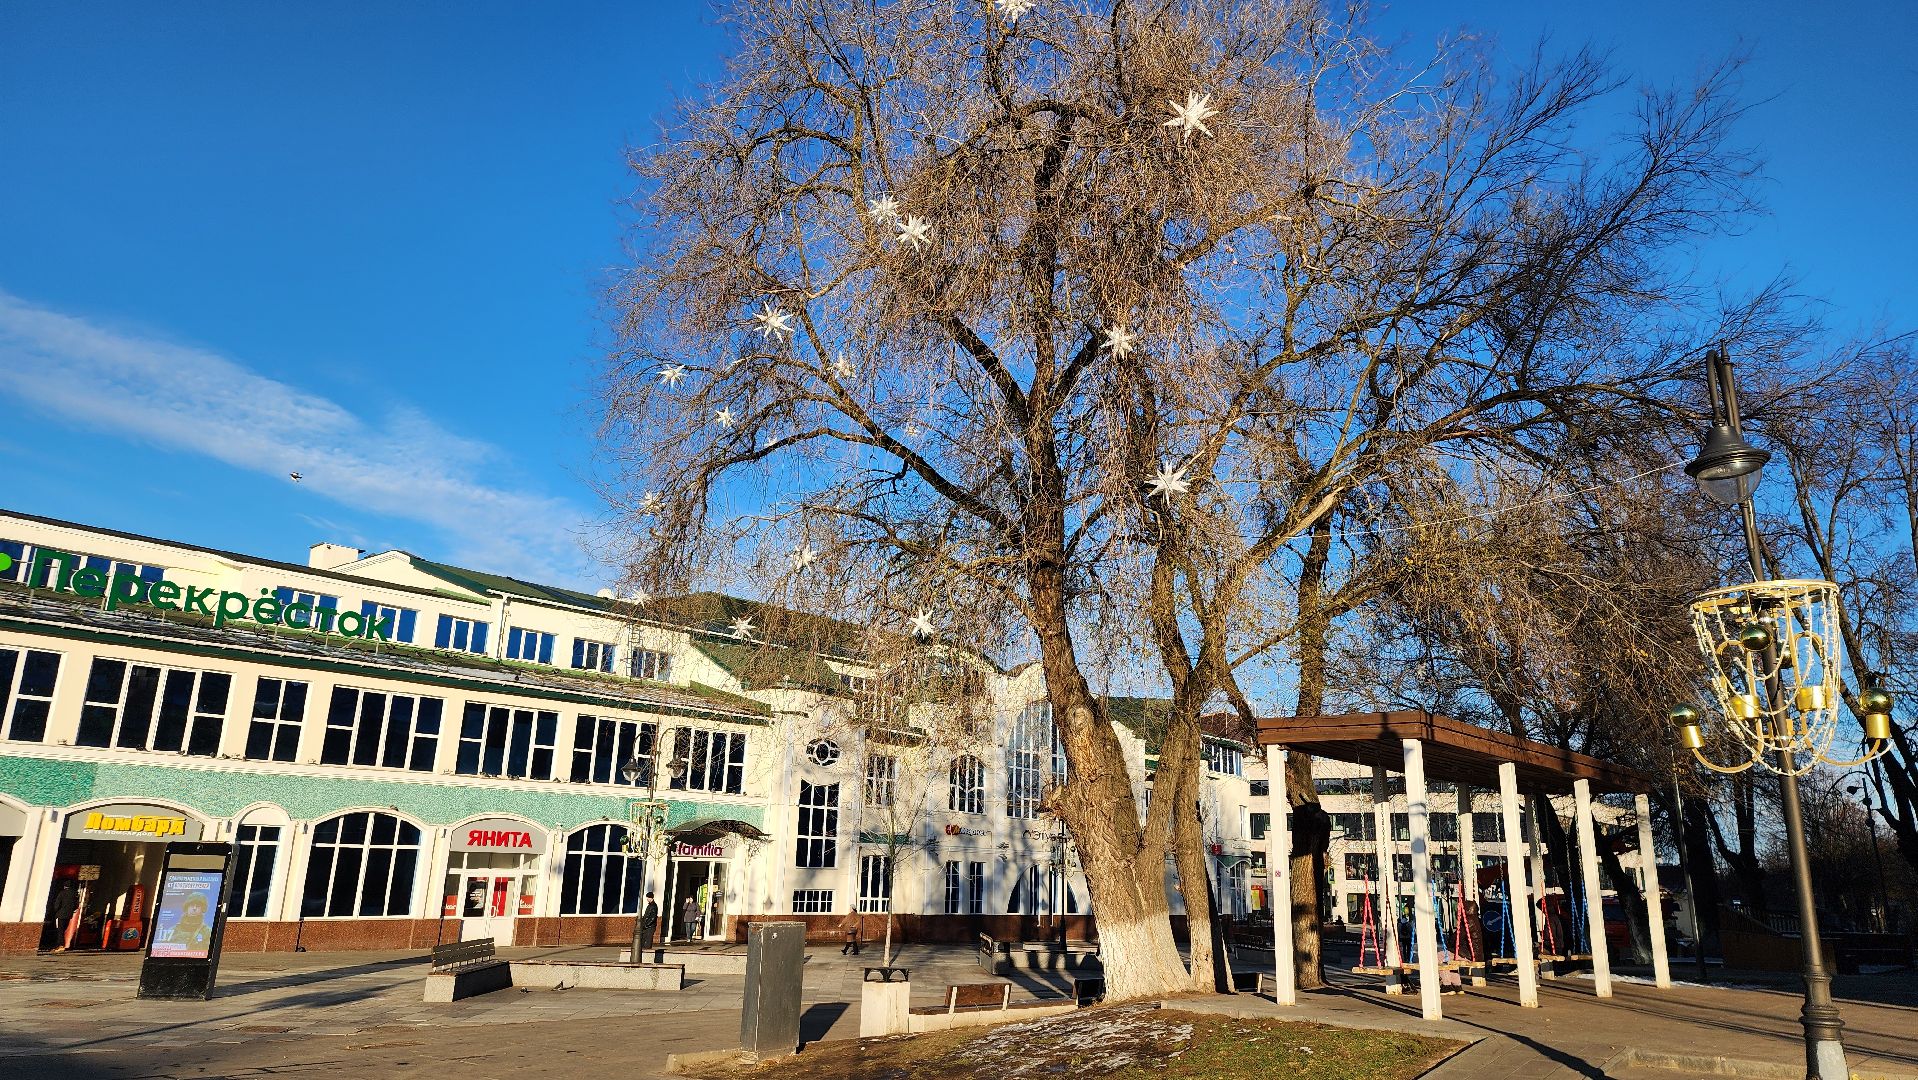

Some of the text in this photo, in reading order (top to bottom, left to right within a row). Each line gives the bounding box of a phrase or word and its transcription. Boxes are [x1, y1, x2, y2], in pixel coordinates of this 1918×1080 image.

[28, 547, 391, 643] Перекрёсток
[84, 812, 187, 837] Ломбард
[467, 830, 532, 848] ЯНИТА
